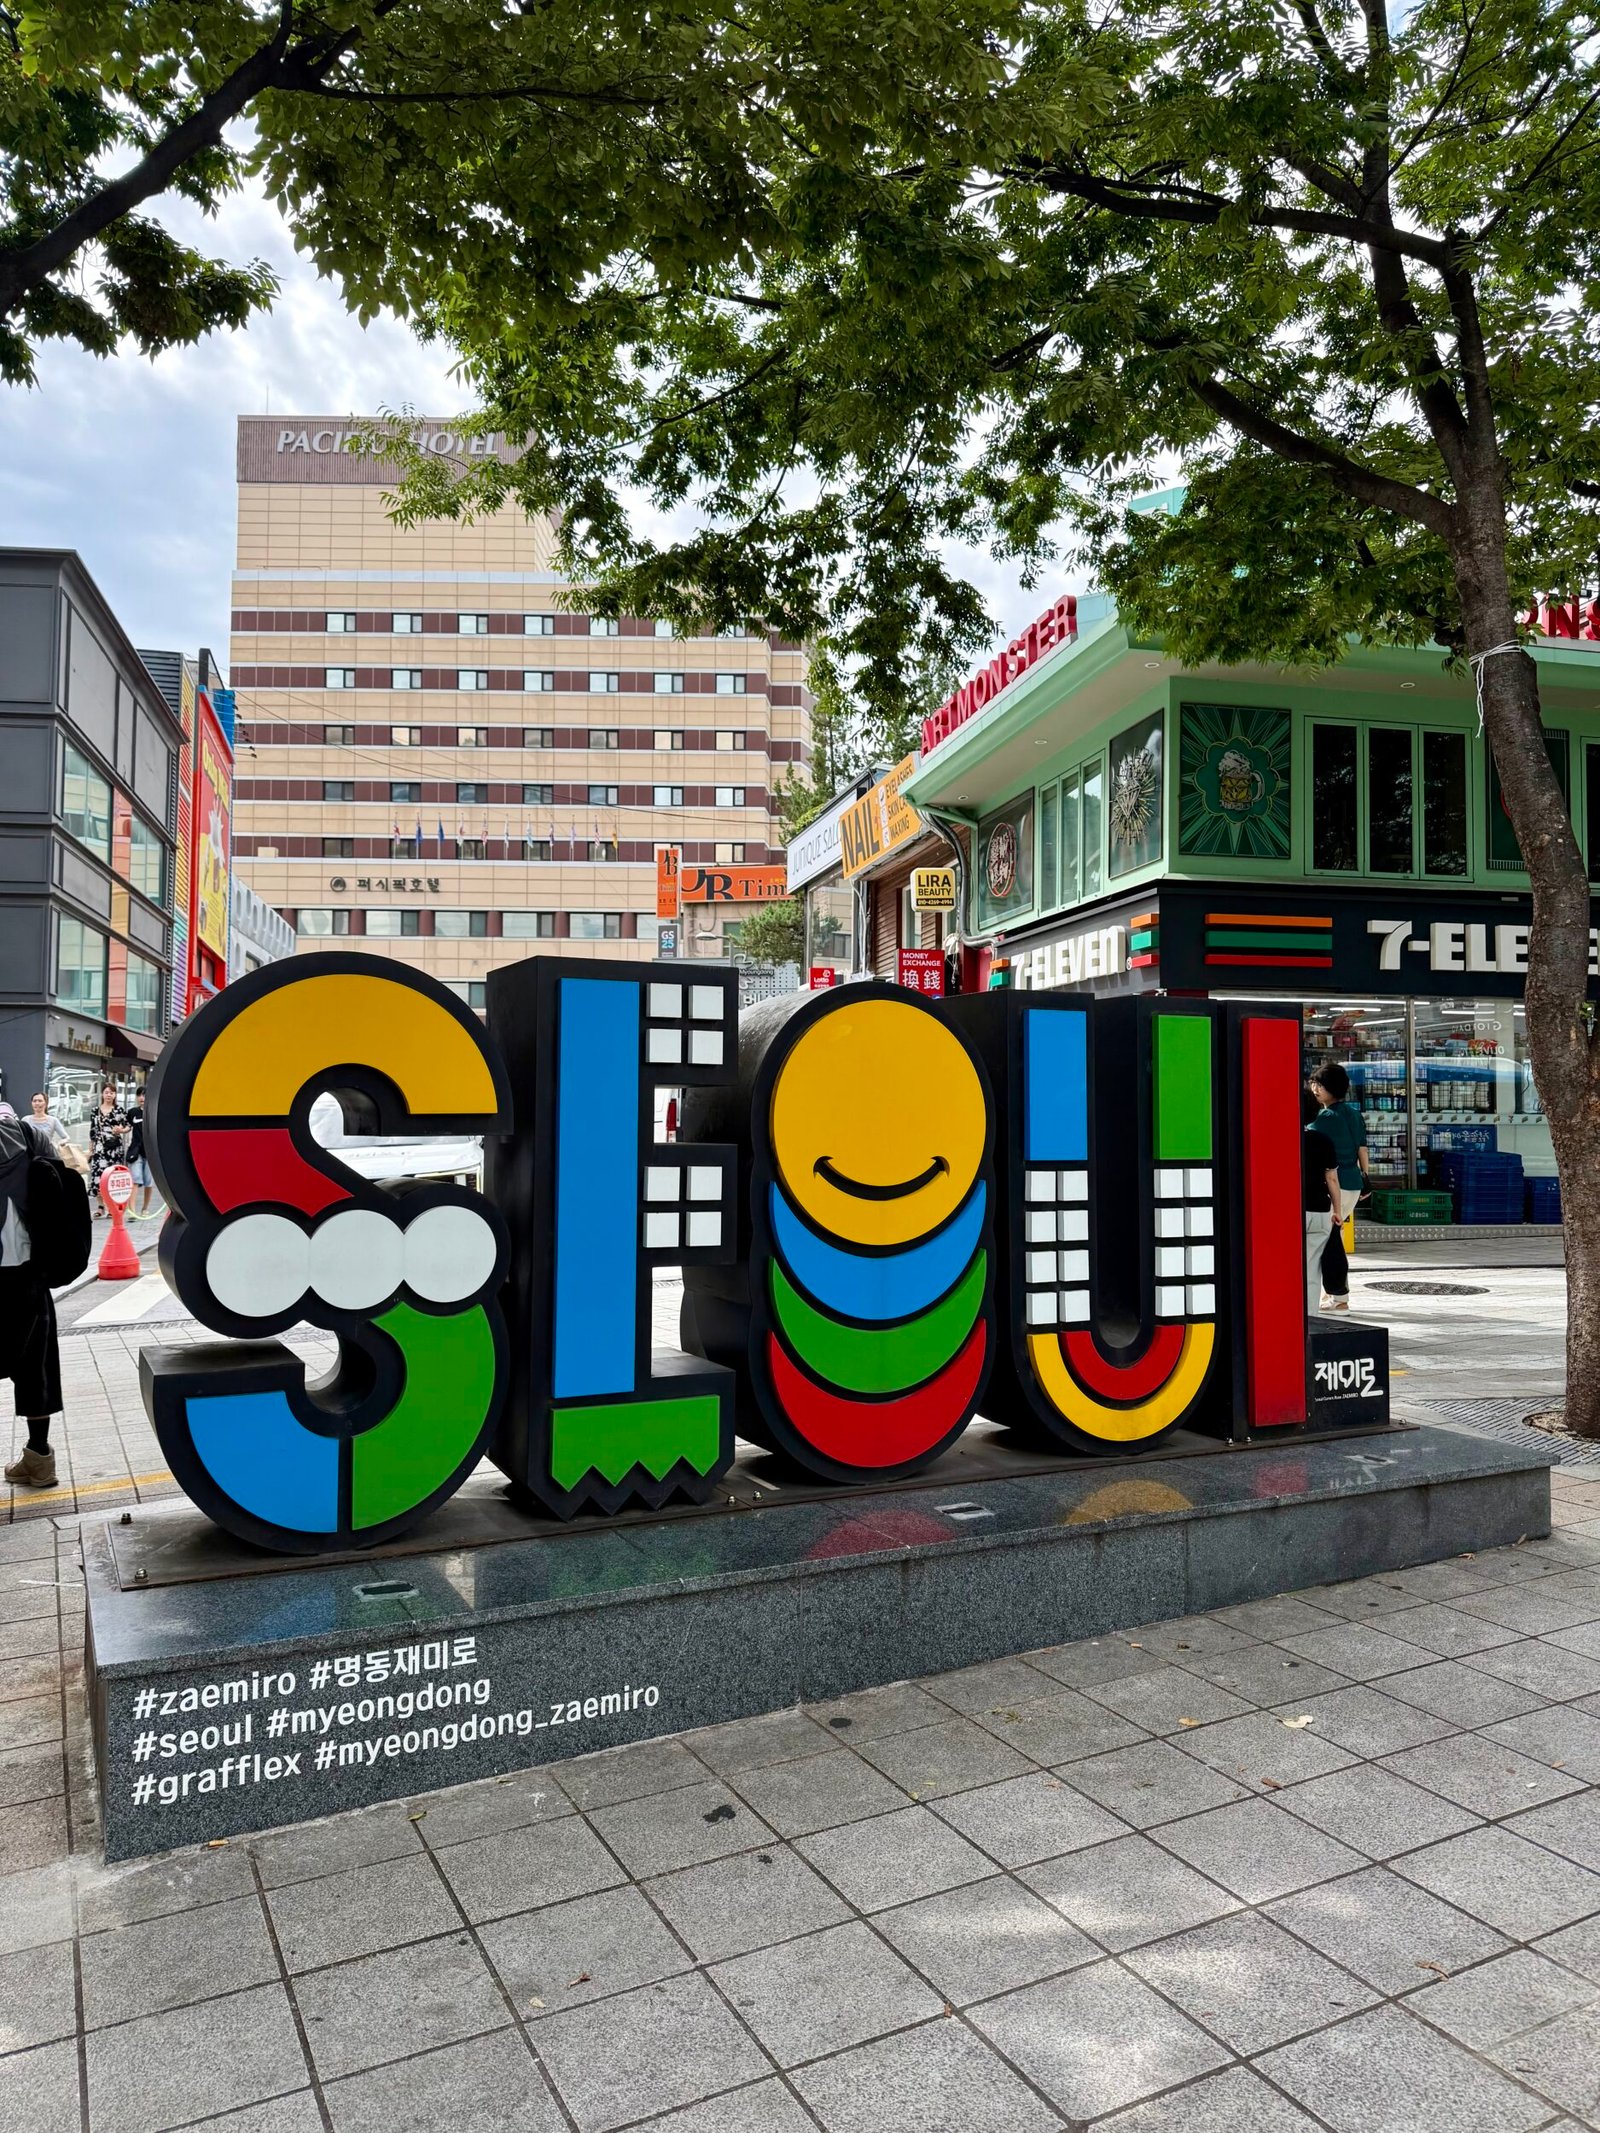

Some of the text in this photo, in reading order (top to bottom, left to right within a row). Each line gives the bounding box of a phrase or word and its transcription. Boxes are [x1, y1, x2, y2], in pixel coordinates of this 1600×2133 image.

[921, 595, 1077, 758] ARTMONSTER
[841, 798, 881, 873] NAIL
[889, 814, 910, 840] WAXING
[357, 877, 440, 893] 퍼시픽호텔
[739, 878, 787, 897] Tim
[917, 874, 952, 888] LIRA
[918, 888, 952, 896] BEAUTY
[661, 930, 675, 939] GS
[661, 939, 675, 949] 25
[902, 952, 929, 960] MONEY
[1367, 920, 1600, 975] 7-ELEE
[902, 969, 941, 990] 換錢
[1314, 1357, 1384, 1398] 재미로
[132, 1636, 478, 1719] #zaemiro #명동재미로
[131, 1678, 490, 1763] #seoul #myeongdong
[130, 1684, 660, 1806] #grafflex #myeongdong_zaemiro
